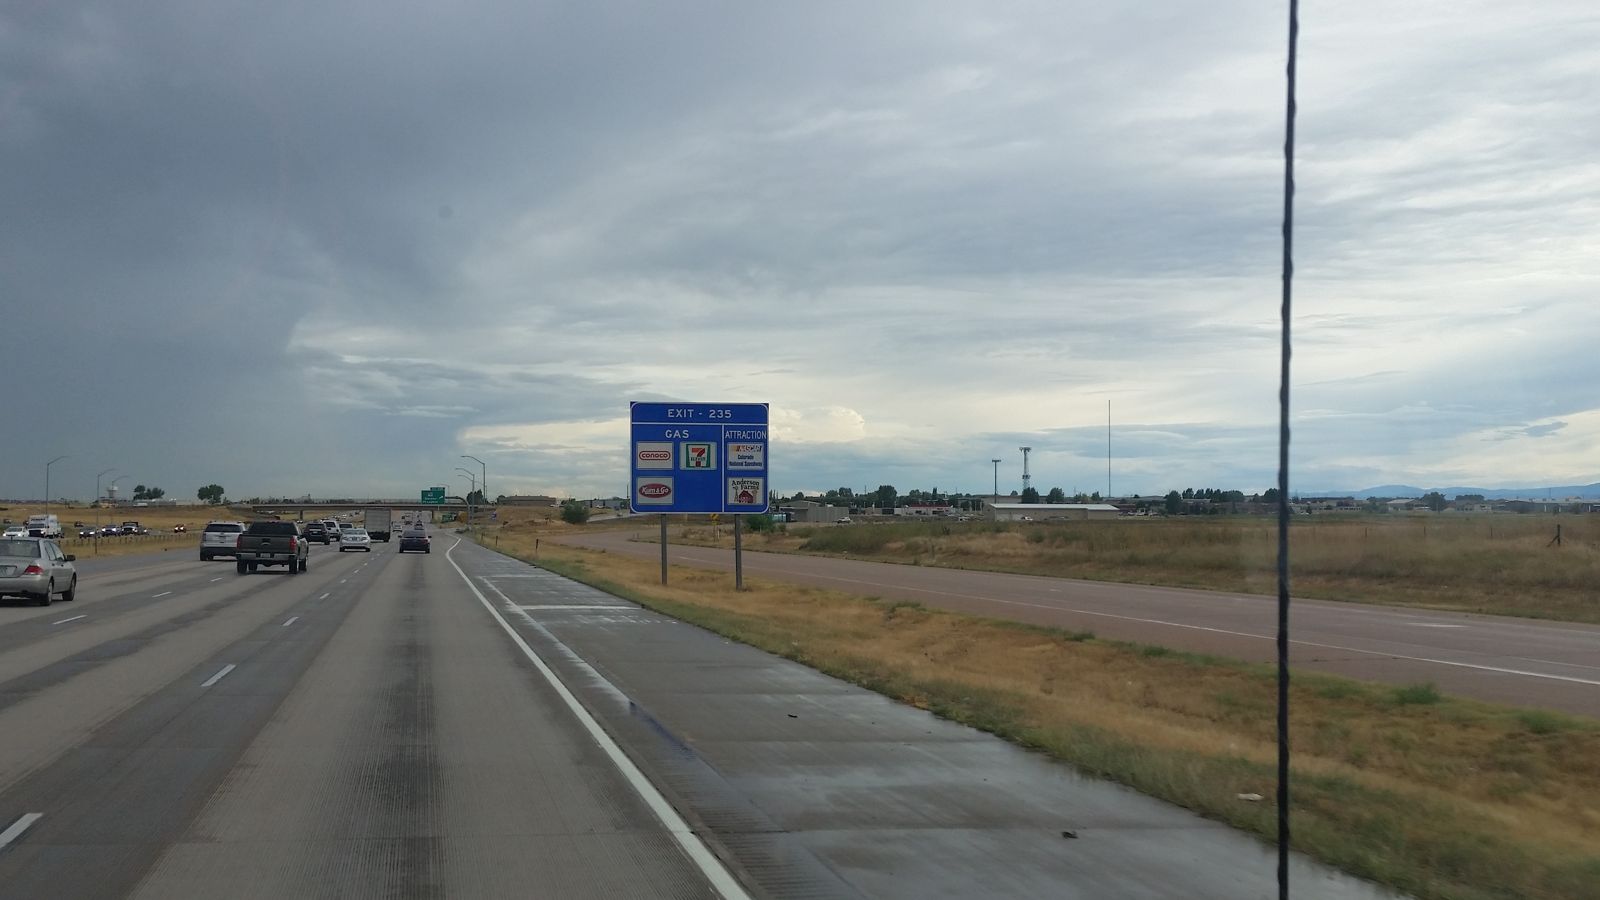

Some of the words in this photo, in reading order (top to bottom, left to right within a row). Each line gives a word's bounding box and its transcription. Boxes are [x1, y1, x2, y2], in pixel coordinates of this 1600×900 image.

[668, 409, 694, 418] EXIT
[709, 409, 732, 418] 235
[665, 430, 689, 439] GAS
[725, 430, 767, 439] ATTRACTION
[732, 478, 760, 486] Anderson
